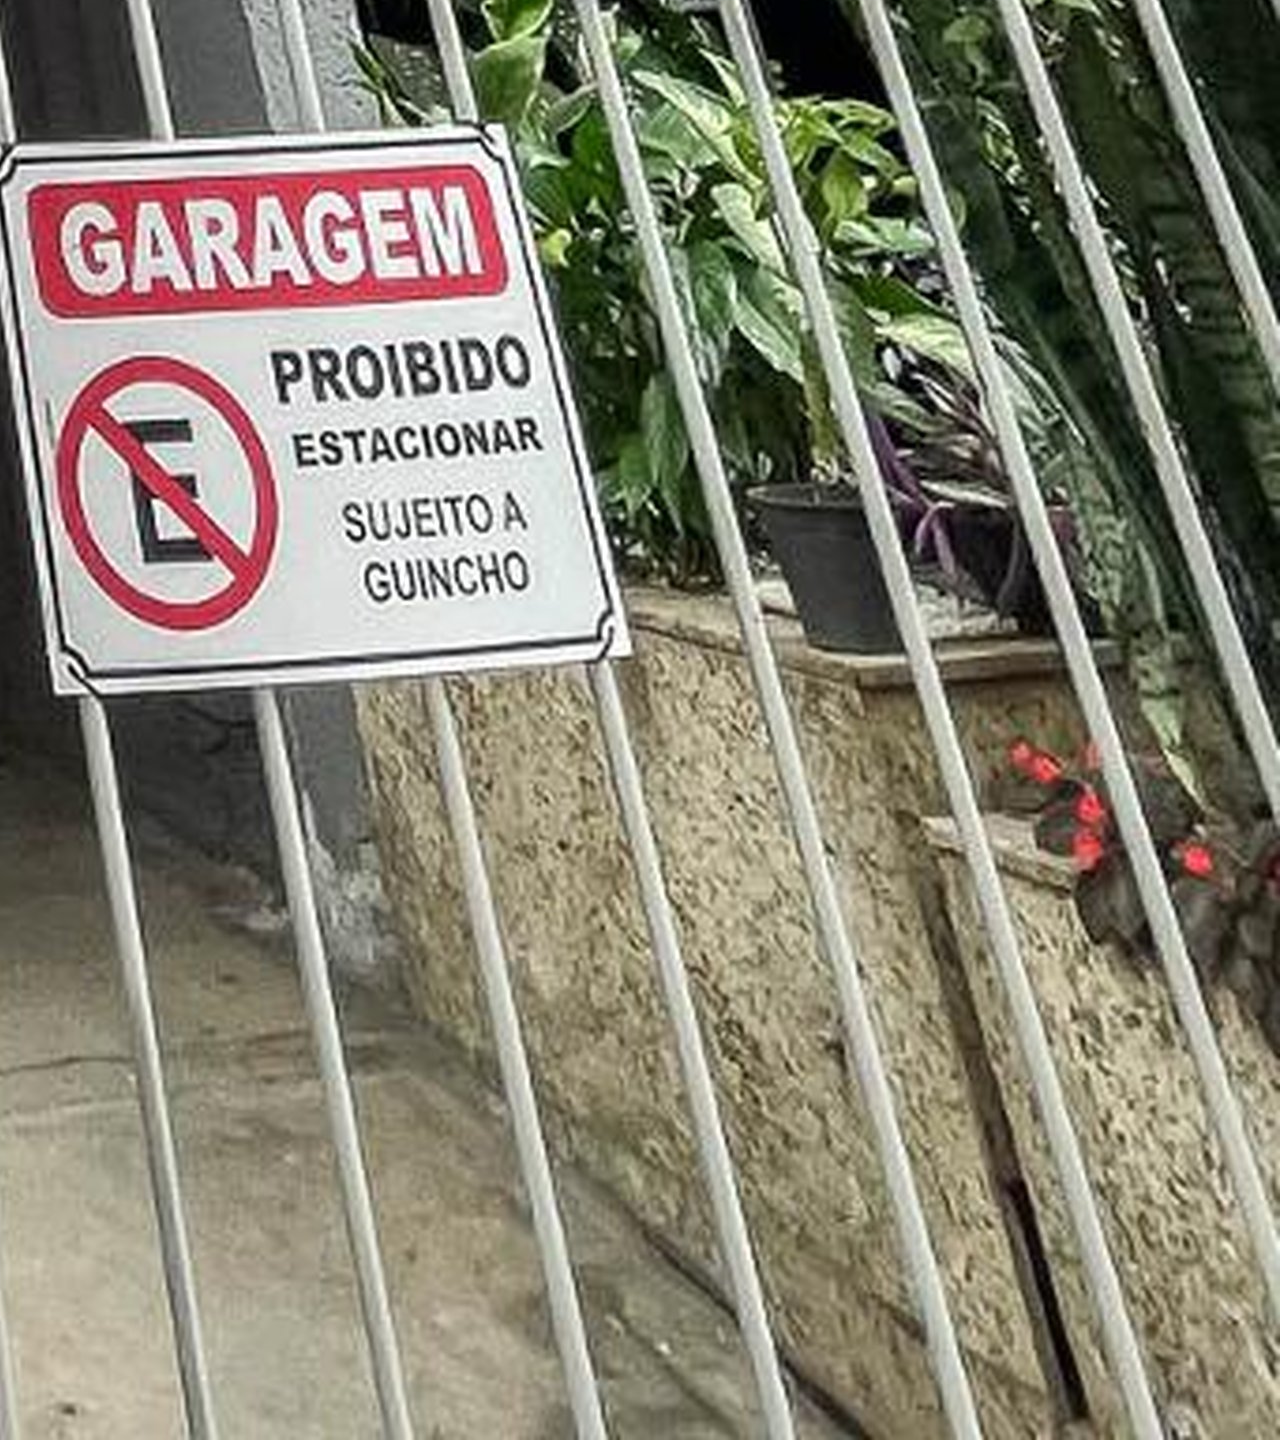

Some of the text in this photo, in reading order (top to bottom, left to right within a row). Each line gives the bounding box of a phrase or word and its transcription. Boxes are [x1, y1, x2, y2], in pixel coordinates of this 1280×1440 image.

[60, 185, 485, 297] GARAGEM
[271, 334, 531, 405] PROIBIDO
[291, 417, 543, 468] ESTACIONAR
[342, 491, 527, 544] SUJEITO A
[363, 549, 530, 604] GUINCHO
